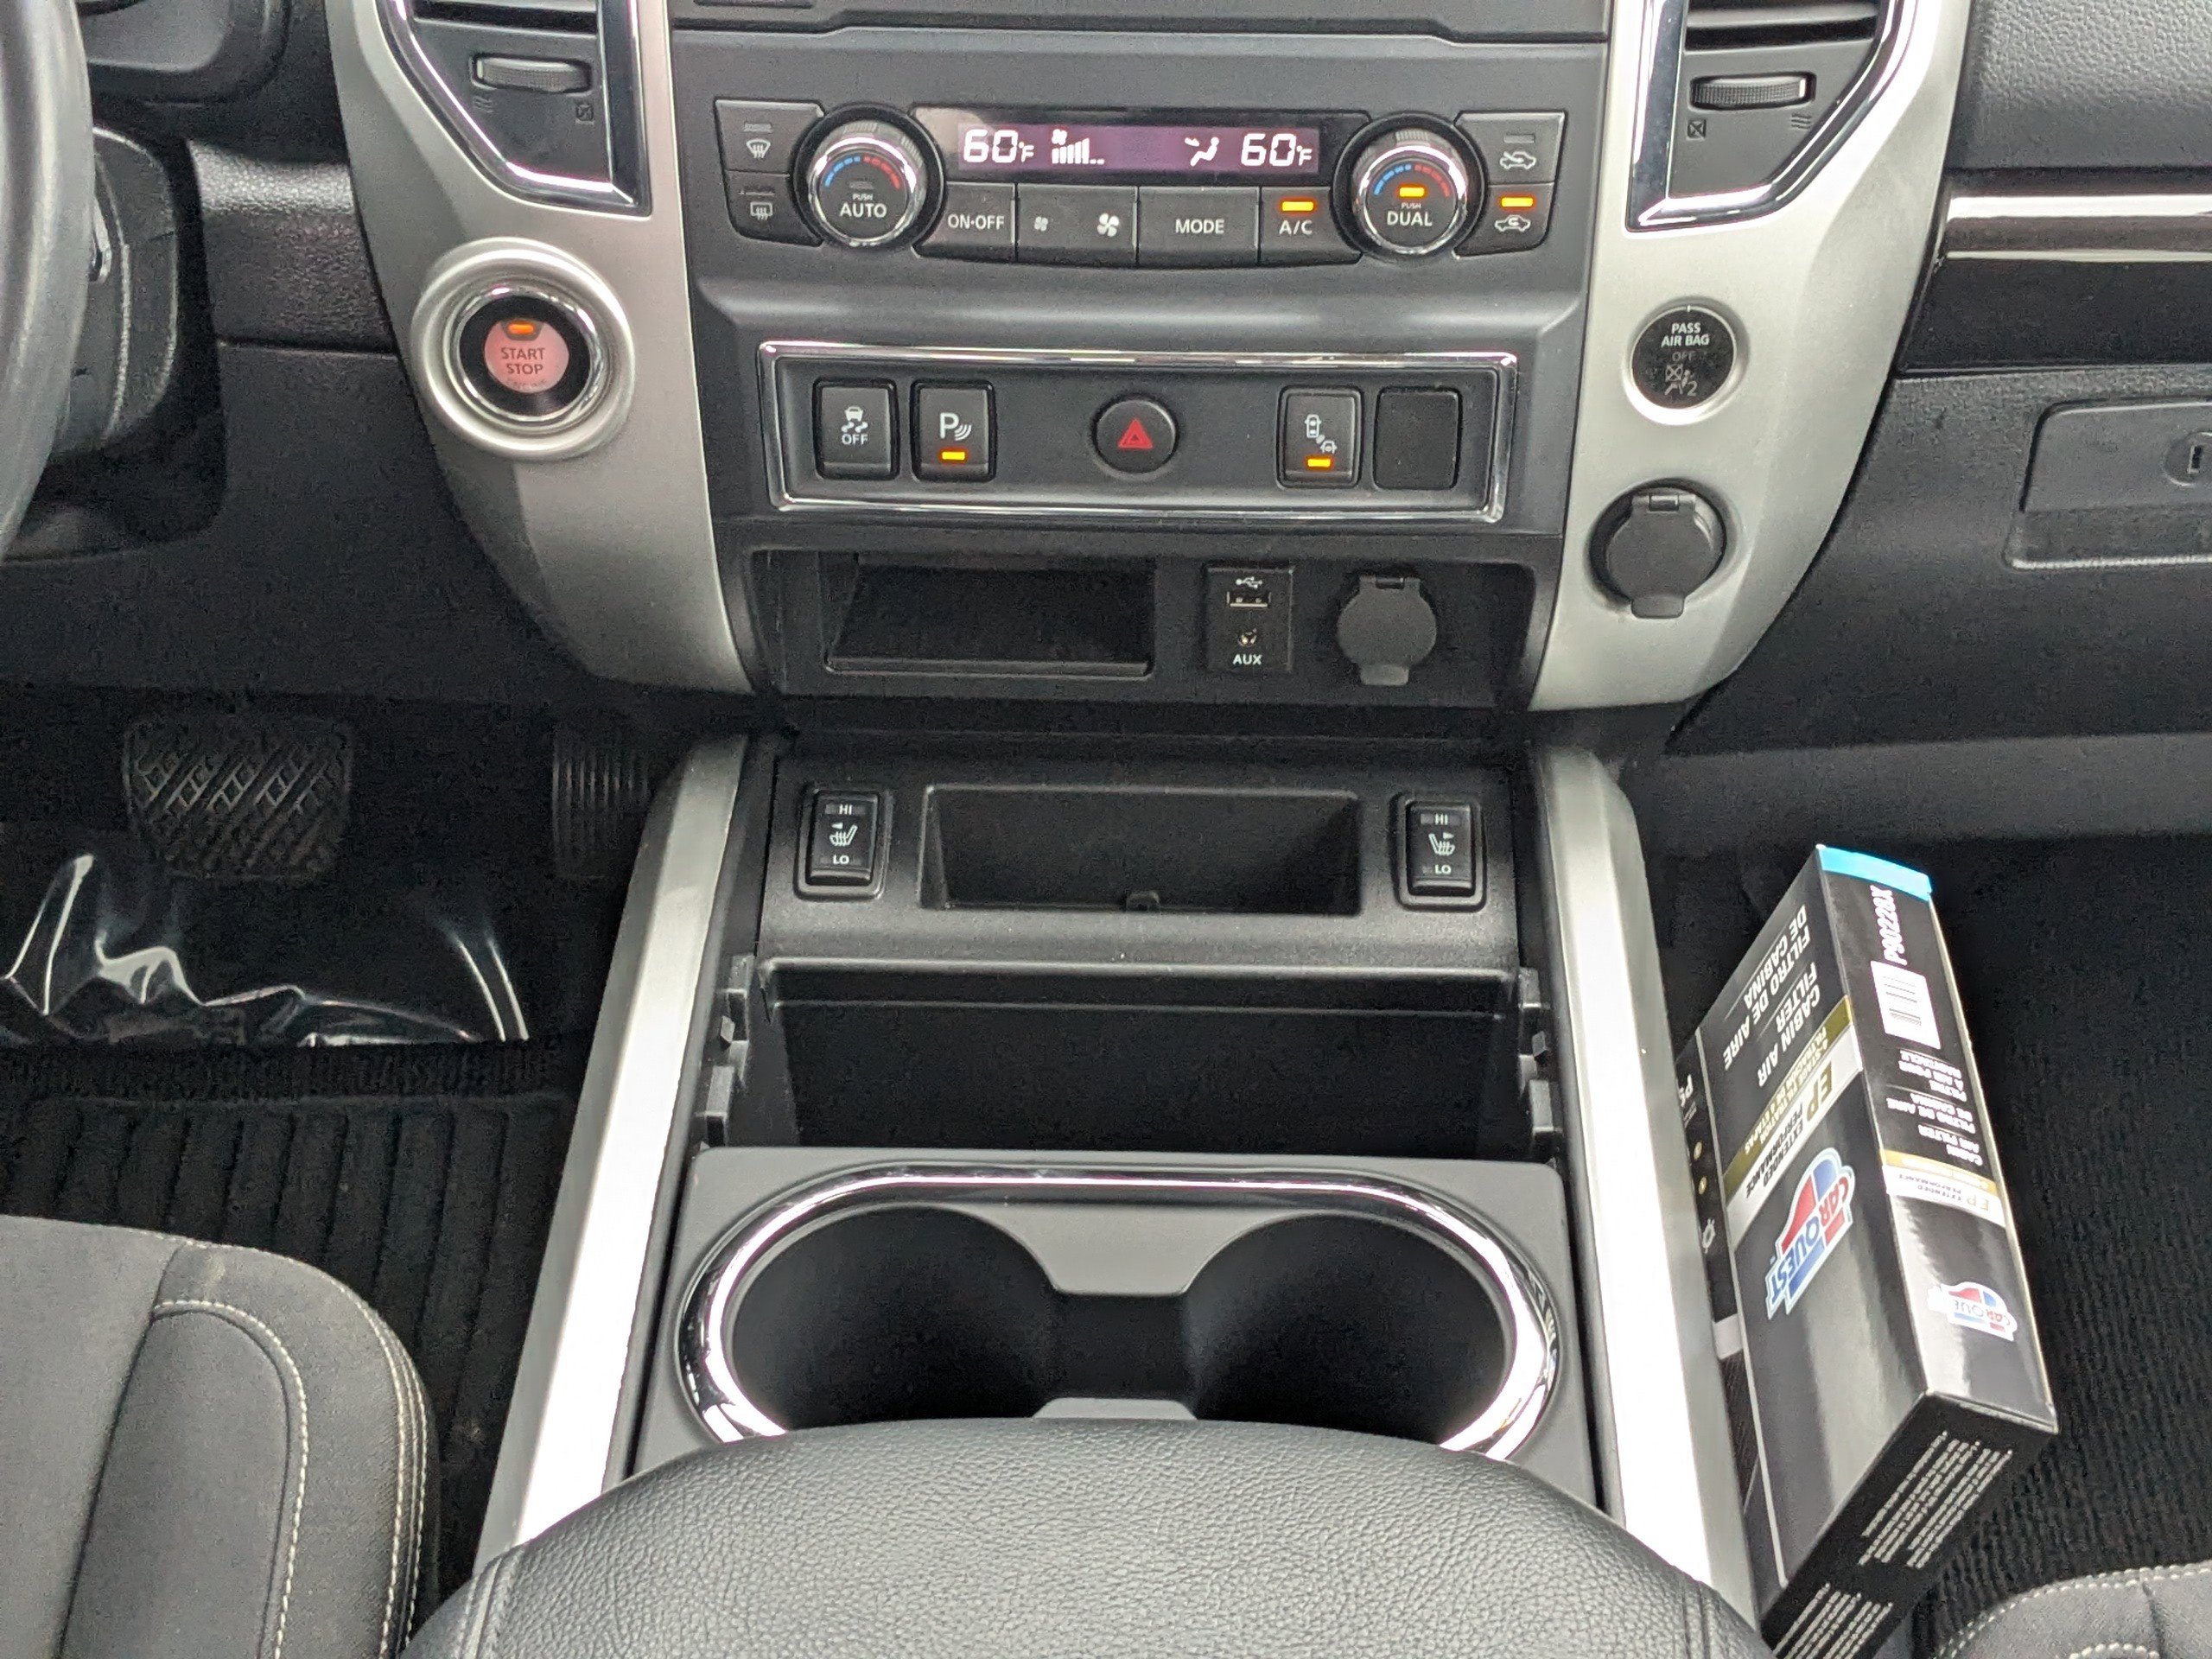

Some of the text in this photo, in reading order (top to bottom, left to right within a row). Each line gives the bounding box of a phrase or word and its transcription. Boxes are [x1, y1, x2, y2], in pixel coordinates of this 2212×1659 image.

[840, 202, 887, 218] AUTO
[1387, 211, 1433, 226] DUAL
[1175, 219, 1224, 234] MODE
[1279, 220, 1313, 235] A/C
[1671, 322, 1701, 334] PASS
[1661, 334, 1710, 347] AIR BAG
[500, 347, 546, 360] START
[505, 364, 543, 375] STOP
[842, 434, 868, 446] OFF
[1232, 654, 1262, 665] AUX
[839, 804, 852, 815] HI
[1434, 814, 1448, 825] HI
[833, 855, 849, 864] LO
[1435, 864, 1452, 874] LO
[1744, 905, 1807, 1010] DE CABINA
[1723, 925, 1810, 1071] FILTRO DE AIRE
[1775, 962, 1817, 1033] FILTER
[1758, 984, 1821, 1087] CABIN AIR
[1745, 1109, 1772, 1154] ETAPAS
[1764, 1061, 1833, 1188] EP EXTENDED
[1918, 1124, 1958, 1146] FILTER
[1746, 1103, 1803, 1198] PERFORMANCE
[1917, 1185, 1961, 1202] EXTENDED
